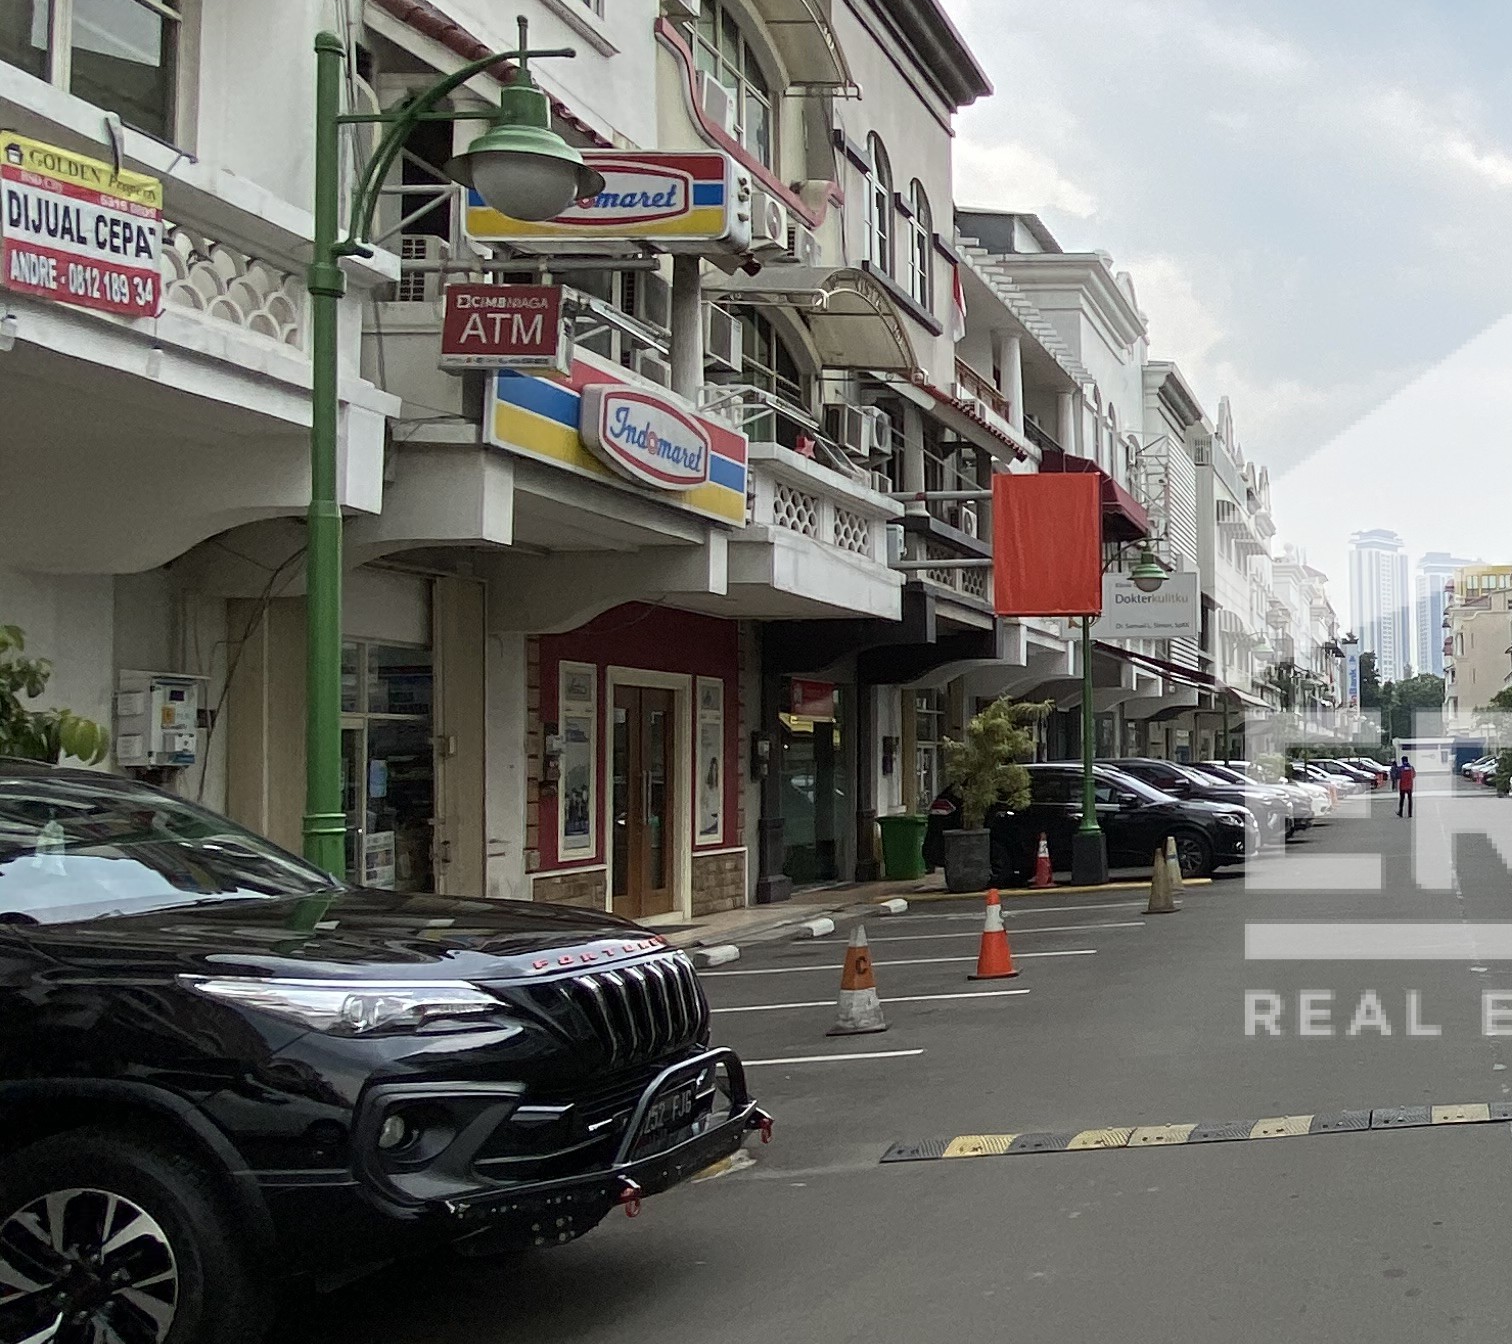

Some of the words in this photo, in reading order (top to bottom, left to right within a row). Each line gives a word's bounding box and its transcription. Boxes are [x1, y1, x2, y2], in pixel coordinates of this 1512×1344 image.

[29, 149, 101, 183] GOLDEN
[8, 189, 87, 245] DIJUAL
[568, 183, 677, 209] omaret
[10, 249, 57, 290] ANDRE
[69, 262, 100, 299] 0812
[459, 313, 543, 345] ATM
[610, 406, 703, 473] Indomaret
